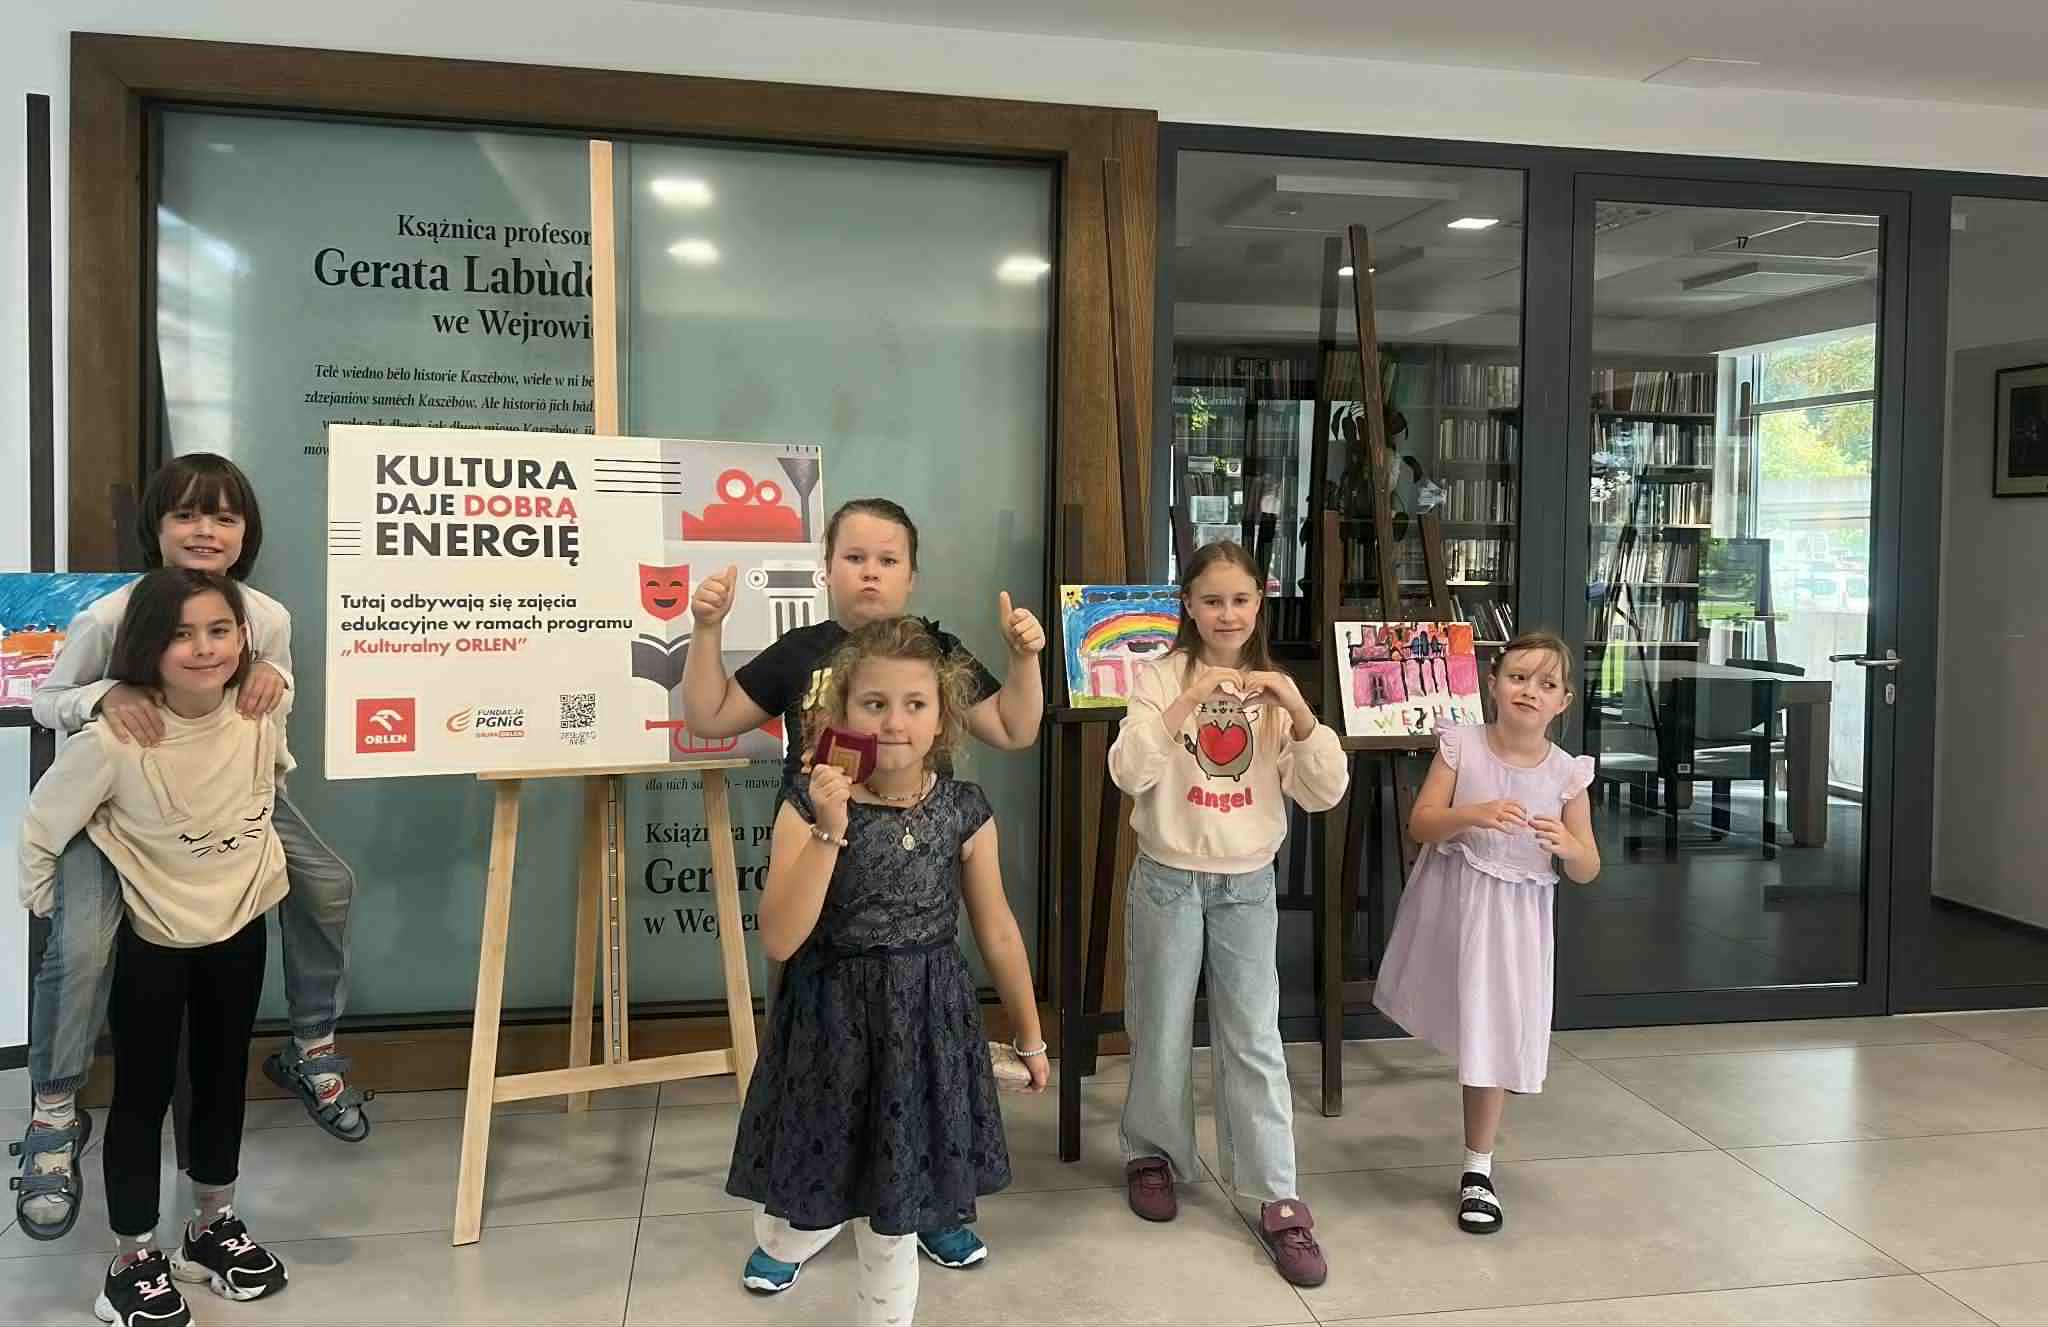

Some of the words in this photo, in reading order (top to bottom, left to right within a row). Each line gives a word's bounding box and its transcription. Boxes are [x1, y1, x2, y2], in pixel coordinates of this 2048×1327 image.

[397, 213, 496, 245] Ksążnica
[1736, 235, 1749, 249] 17
[314, 247, 449, 291] Gerata
[431, 314, 470, 334] we
[477, 308, 593, 345] Wejrowi
[376, 454, 577, 490] KULTURA
[376, 492, 455, 516] DAJE
[463, 493, 577, 524] DOBRĄ
[376, 521, 579, 566] ENERGIĘ
[341, 594, 385, 612] Tutaj
[390, 593, 484, 612] odbywają
[489, 594, 513, 611] się
[517, 593, 577, 612] zajęcia
[341, 615, 449, 634] edukacyjne
[453, 620, 471, 630] w
[475, 615, 543, 630] ramach
[547, 619, 633, 633] programu
[475, 716, 524, 728] PGNiG
[364, 734, 407, 744] ORLEN
[1187, 786, 1253, 813] Angel
[643, 917, 665, 935] w
